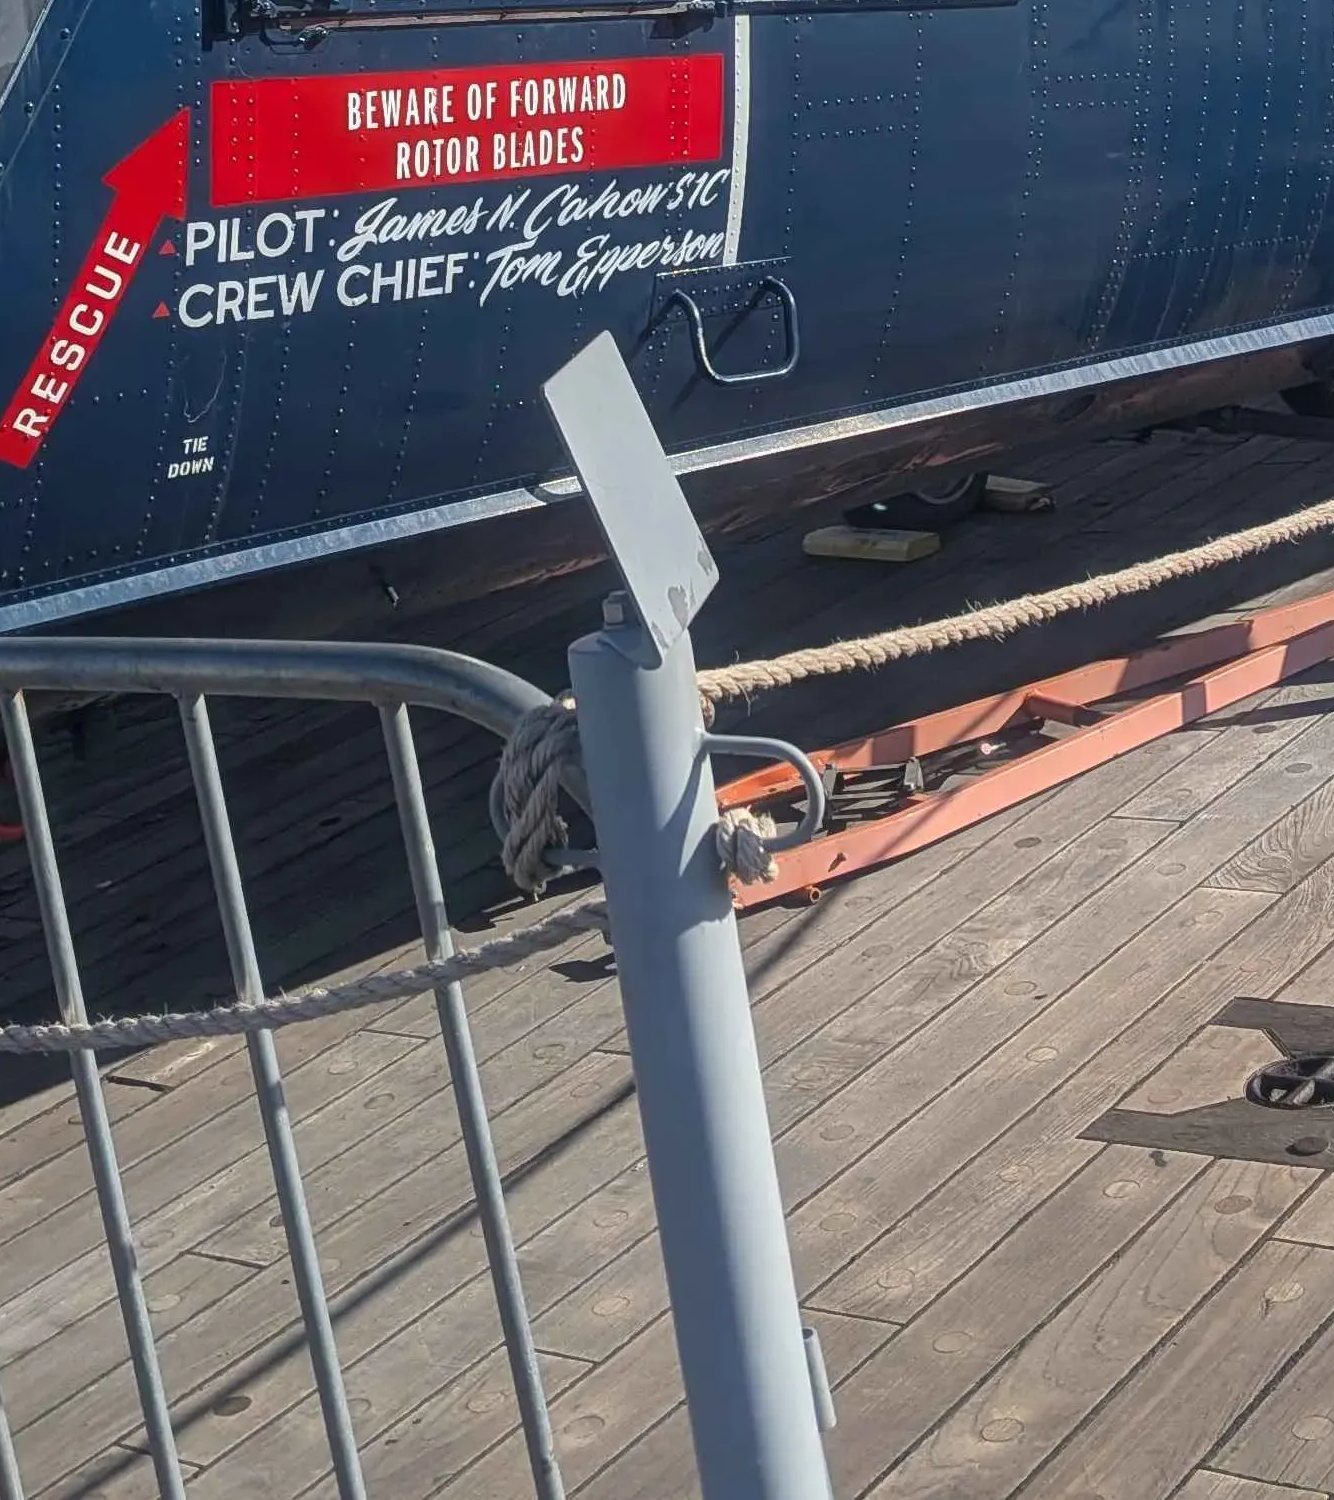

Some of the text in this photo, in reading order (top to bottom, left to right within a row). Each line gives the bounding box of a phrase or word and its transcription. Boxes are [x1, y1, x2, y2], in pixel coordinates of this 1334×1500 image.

[347, 73, 627, 130] BEWARE OF FORWARD
[396, 126, 584, 180] ROTOR BLADES
[185, 208, 340, 267] PILOT:
[336, 197, 489, 262] James
[485, 189, 531, 232] N.
[523, 179, 669, 241] Cahow
[178, 229, 725, 328] CREW CHIEF: Tom Epperson
[12, 231, 140, 438] RESCUE
[167, 456, 215, 479] DOWN
[182, 436, 209, 454] TIE
